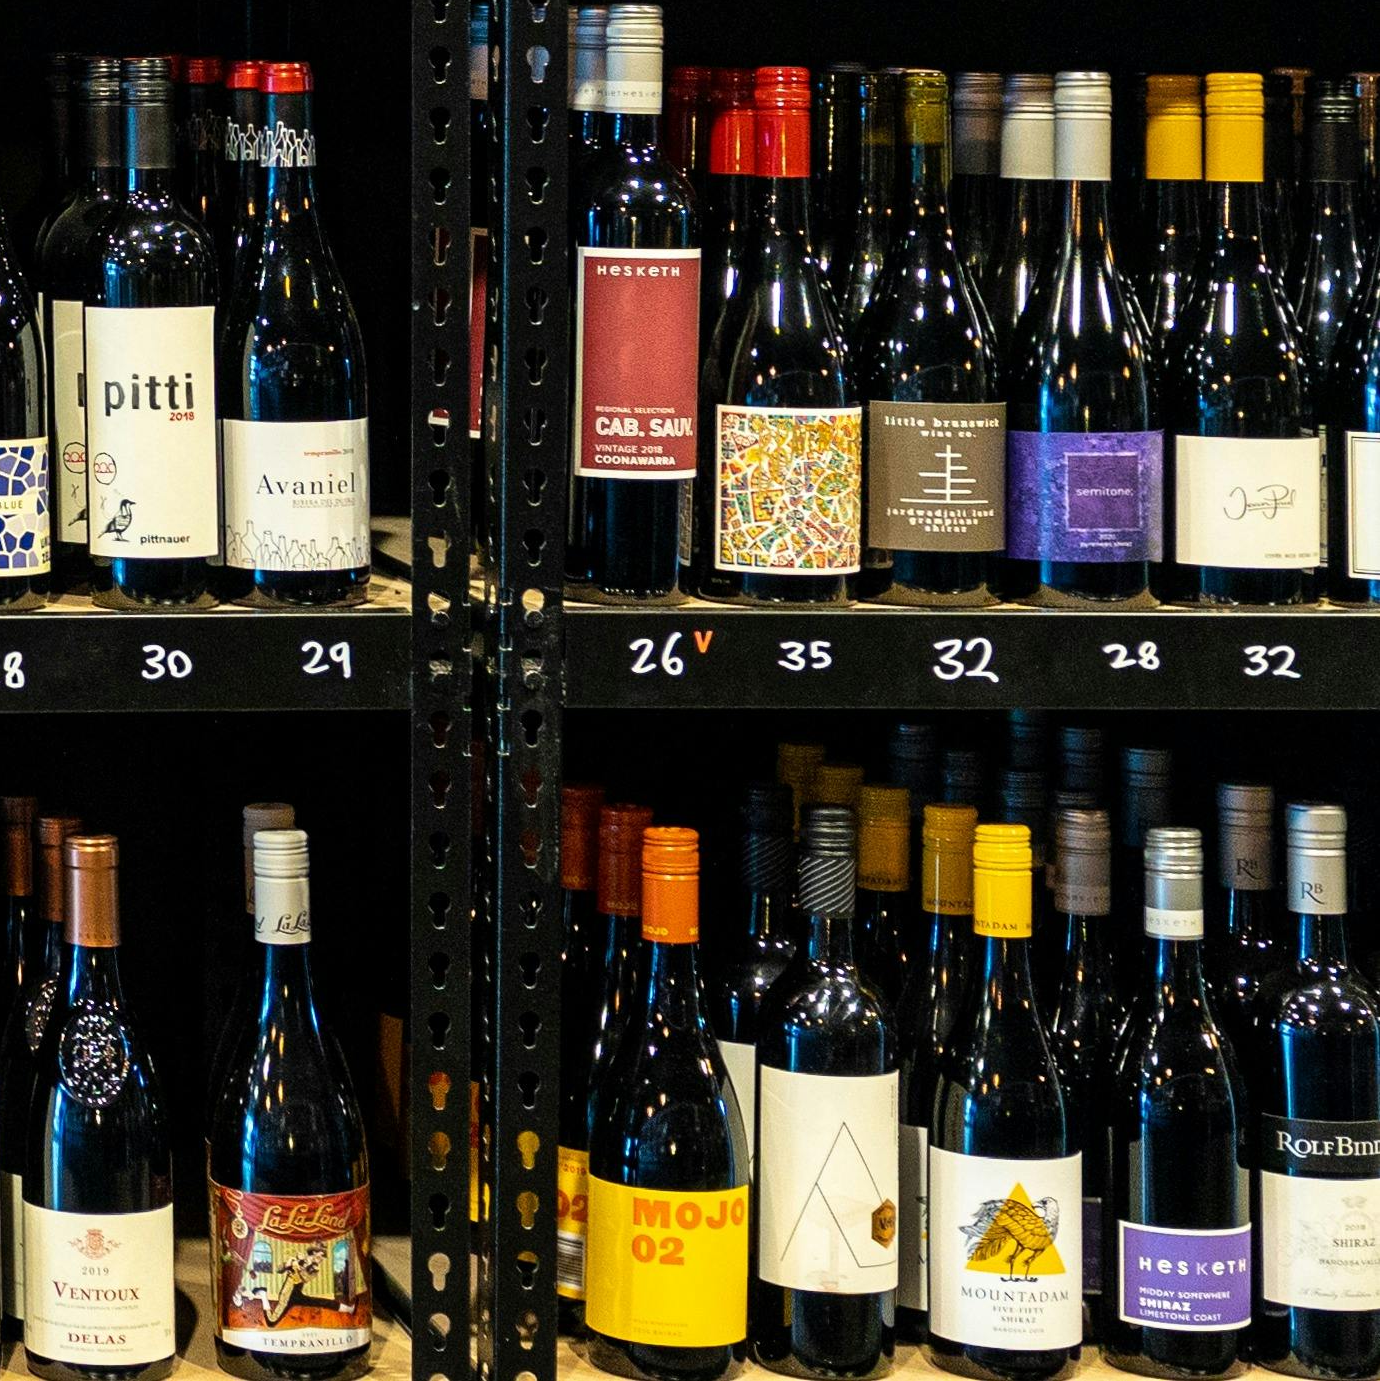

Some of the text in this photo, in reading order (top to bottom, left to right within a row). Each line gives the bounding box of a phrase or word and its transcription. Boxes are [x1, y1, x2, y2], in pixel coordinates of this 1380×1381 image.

[104, 373, 194, 416] pitti
[169, 412, 194, 421] 2018
[594, 454, 675, 466] COONAWARRA
[595, 444, 663, 454] VINTAGE 2018
[256, 473, 356, 495] Avaniel
[140, 534, 190, 544] pittnauer
[141, 644, 193, 680] 30
[301, 640, 352, 679] 29
[628, 631, 684, 676] 26
[777, 640, 833, 672] 35
[932, 637, 1000, 684] 32
[1102, 640, 1161, 671] 28
[1243, 644, 1302, 679] 32
[633, 1196, 745, 1229] MOJO
[632, 1236, 684, 1266] 02
[82, 1266, 109, 1275] 2019
[53, 1281, 139, 1301] VENTOUX
[960, 1285, 1069, 1301] MOUNTADAM
[1140, 1297, 1191, 1311] SHIRAZ
[68, 1333, 125, 1345] DELAS
[262, 1333, 353, 1348] TEMPRANILLO
